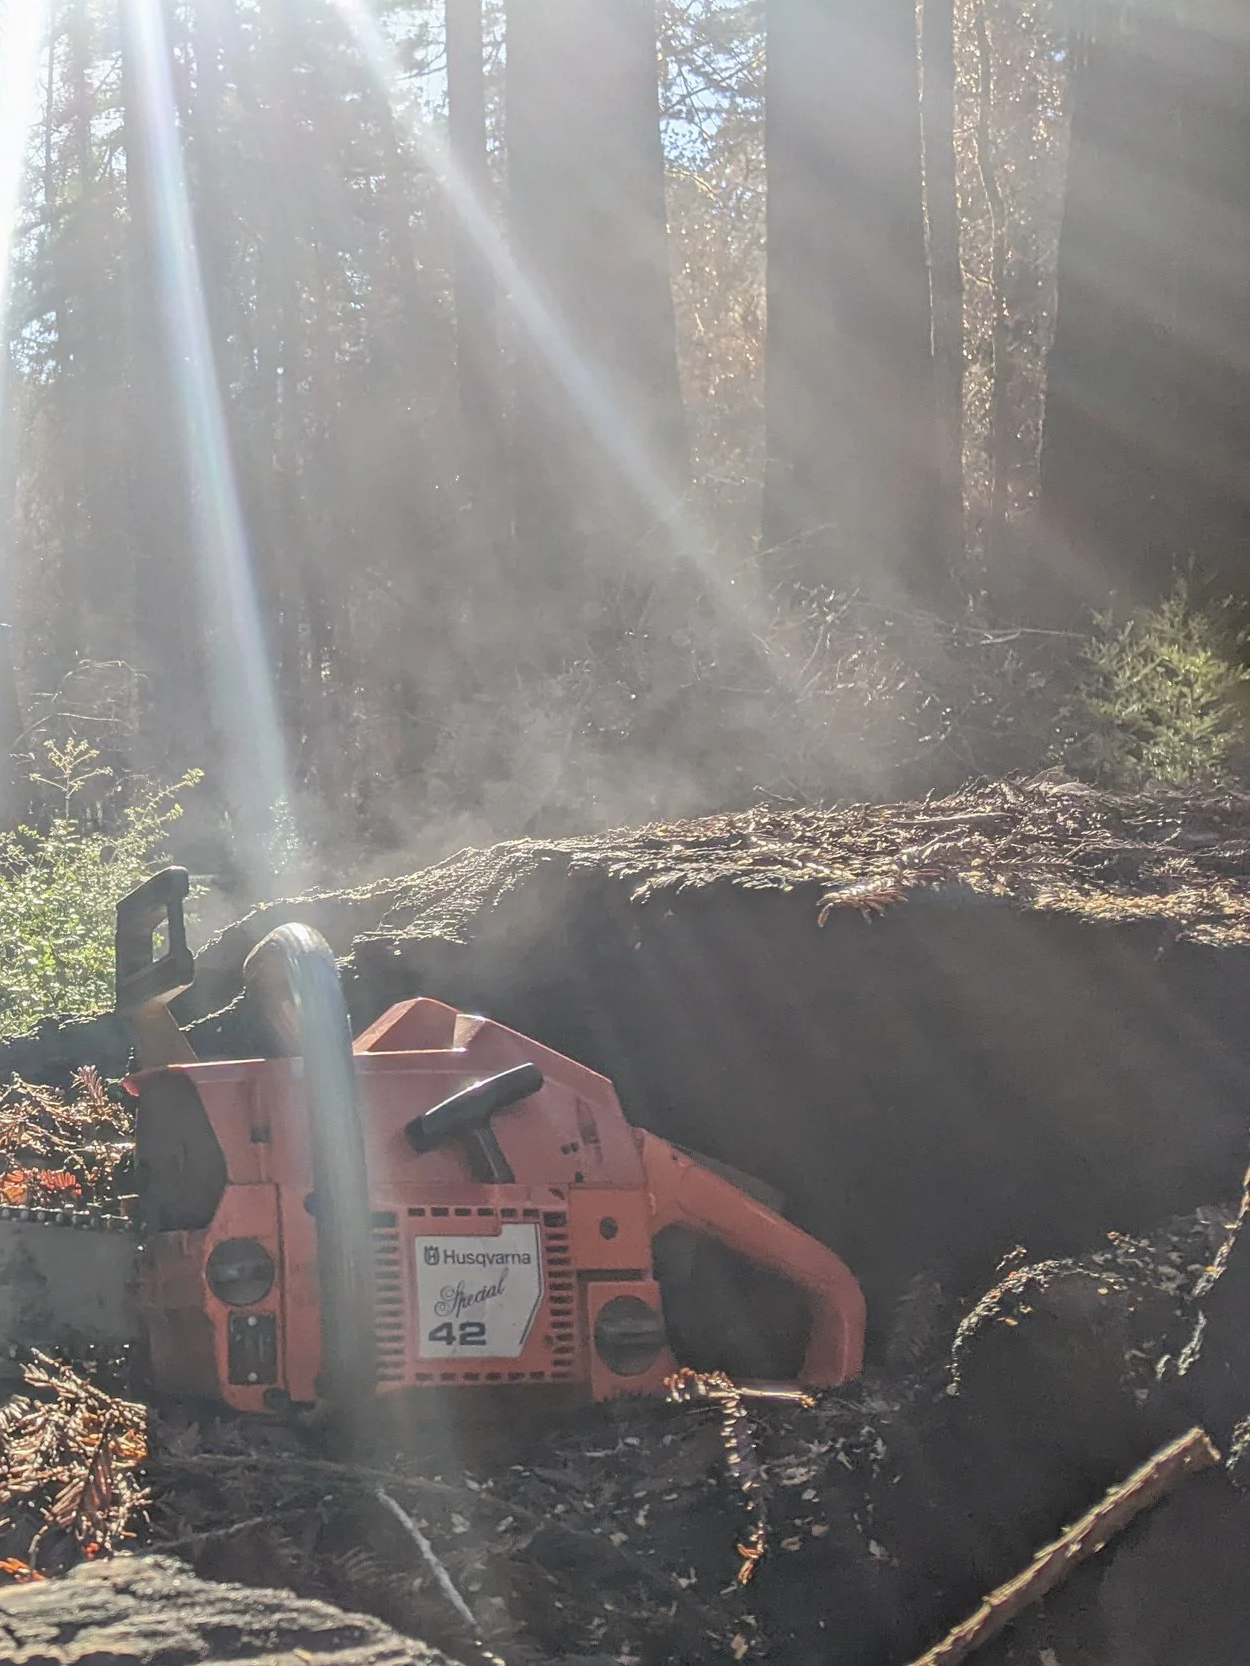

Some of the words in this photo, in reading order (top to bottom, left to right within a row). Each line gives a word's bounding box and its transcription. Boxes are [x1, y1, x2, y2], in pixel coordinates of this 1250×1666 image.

[443, 1249, 531, 1267] Husqvarna
[434, 1267, 509, 1318] Special
[428, 1321, 487, 1346] 42
